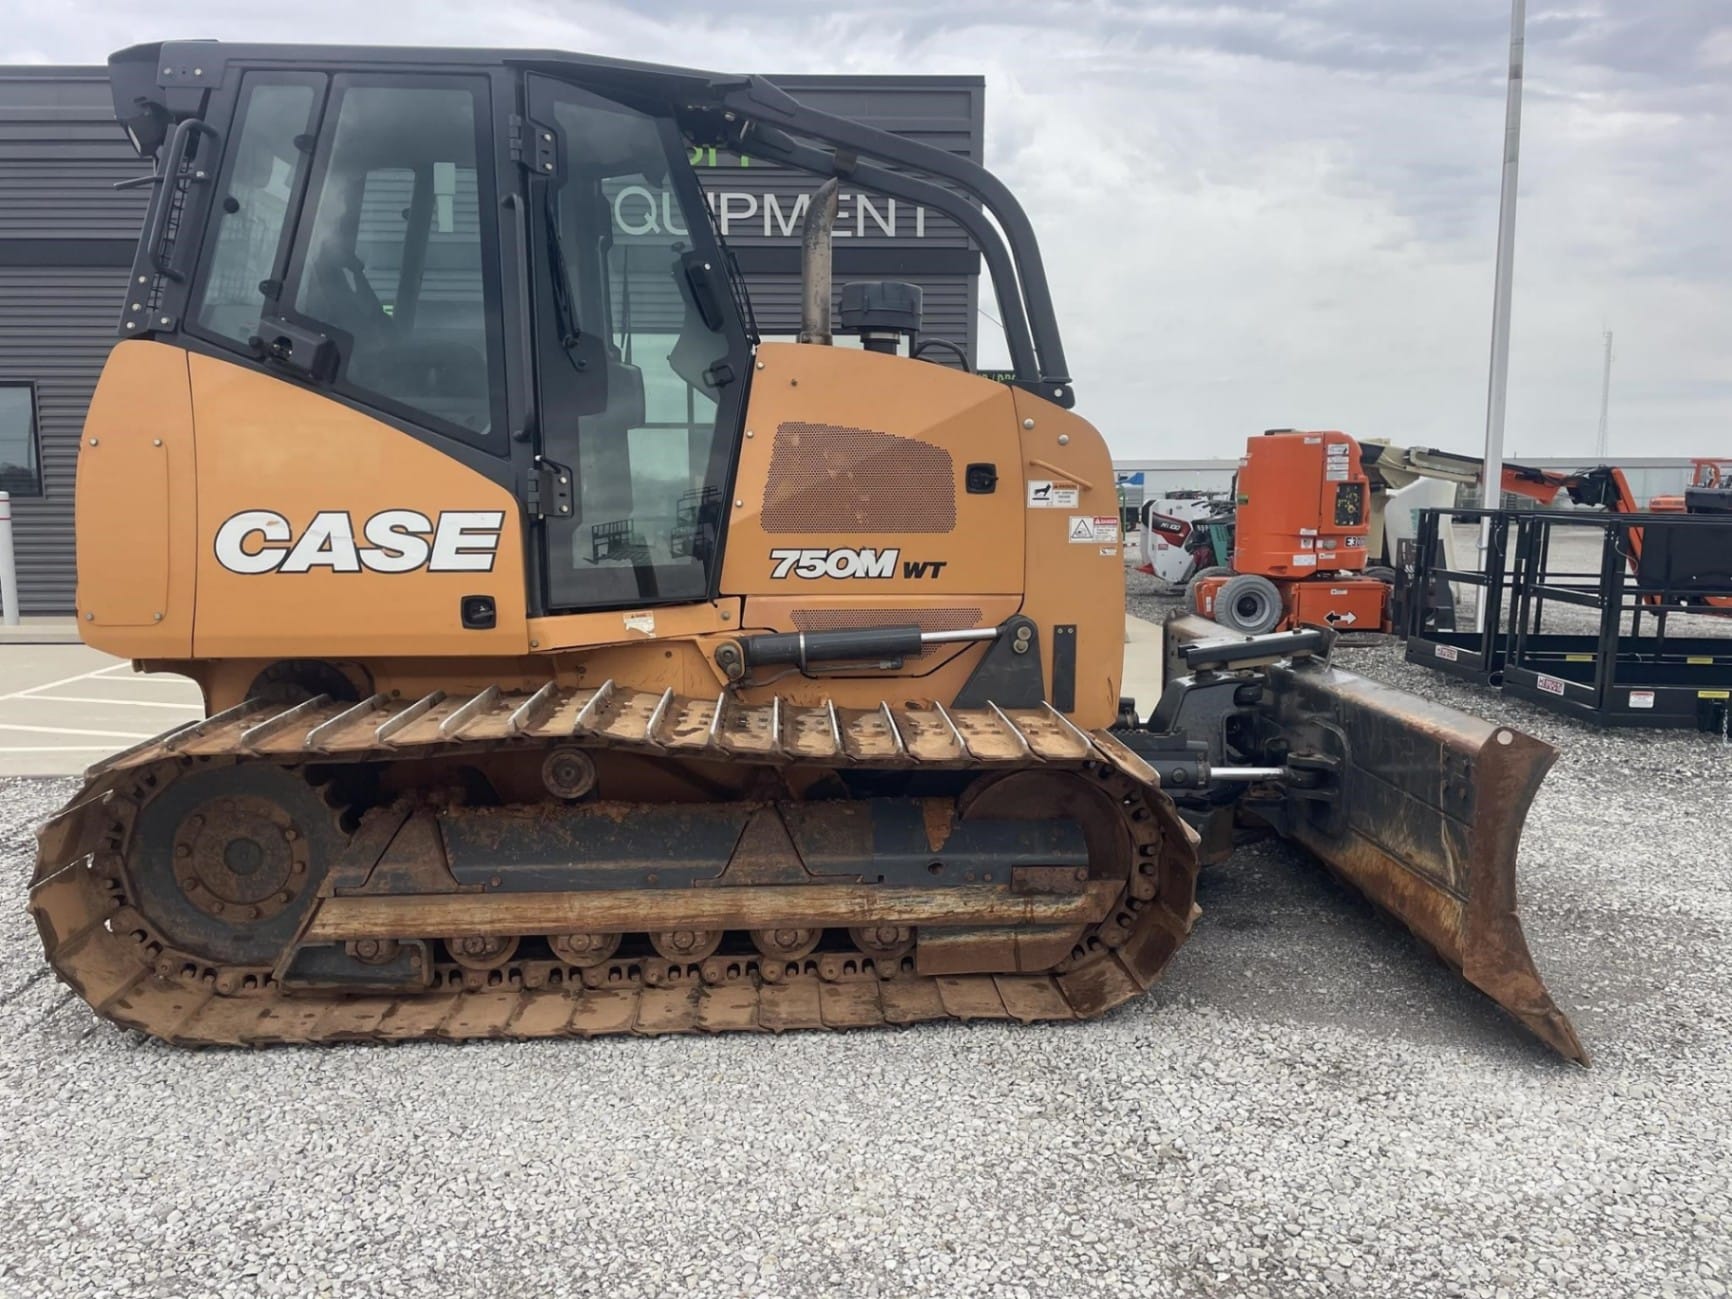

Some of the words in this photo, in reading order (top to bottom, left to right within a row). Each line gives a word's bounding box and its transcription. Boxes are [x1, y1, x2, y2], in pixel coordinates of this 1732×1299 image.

[214, 508, 505, 575] CASE
[769, 546, 900, 579] 750M
[903, 562, 947, 579] WT
